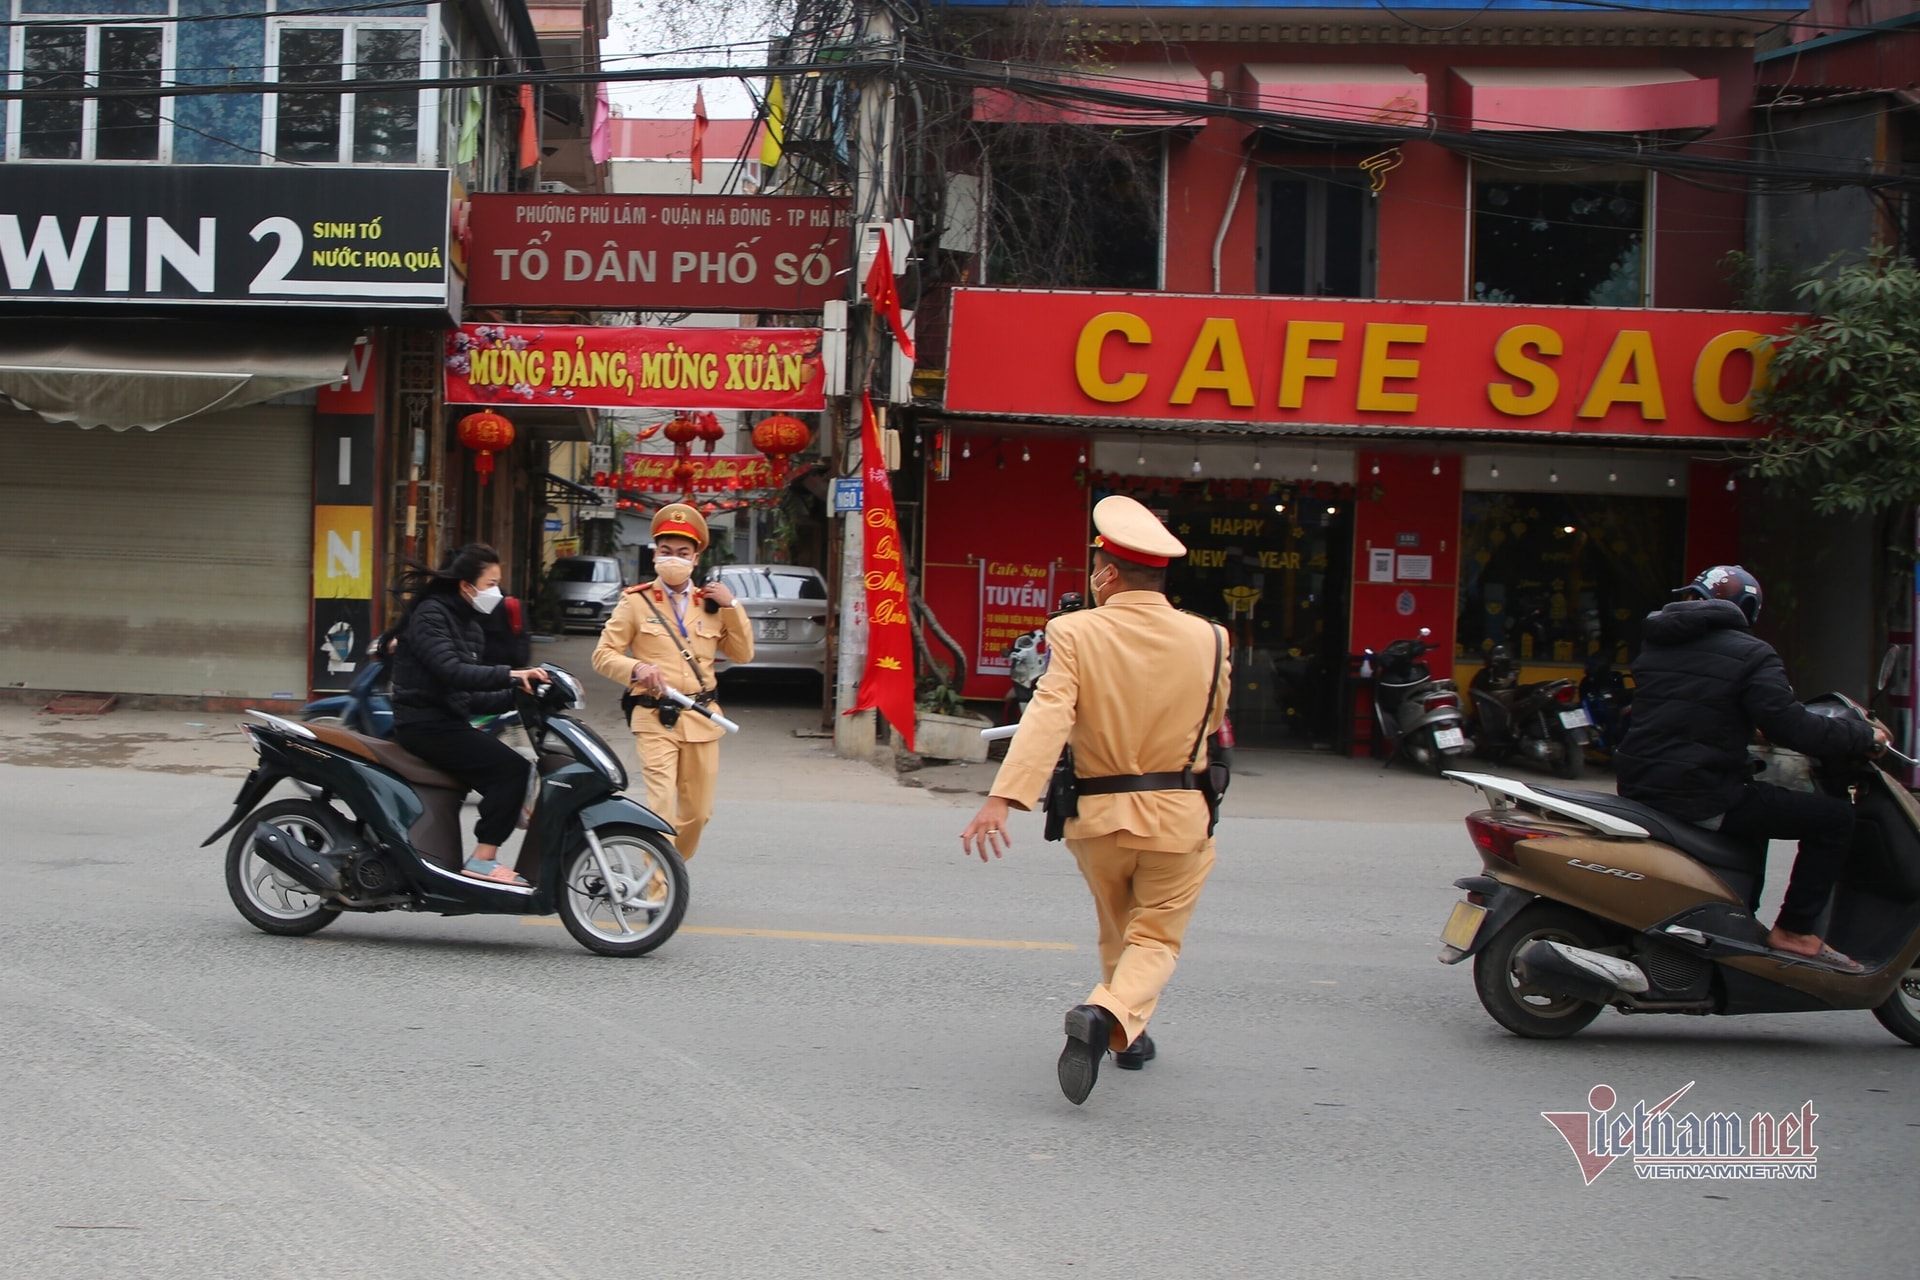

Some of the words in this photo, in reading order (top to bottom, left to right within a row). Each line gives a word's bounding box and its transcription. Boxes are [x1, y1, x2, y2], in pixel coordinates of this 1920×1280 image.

[312, 222, 356, 239] SINH
[360, 217, 382, 240] TỐ
[661, 202, 702, 229] QUẬN
[729, 203, 771, 227] ĐÔNG
[787, 209, 806, 227] TP
[0, 214, 217, 293] WIN
[248, 216, 304, 294] 2
[312, 247, 362, 268] NƯỚC
[365, 251, 401, 269] HOA
[404, 245, 442, 273] QUẢ
[494, 230, 551, 281] TỔ
[563, 240, 657, 283] DÂN
[671, 235, 760, 285] PHỐ
[773, 238, 840, 286] SỐ
[468, 339, 546, 387] MỪNG
[551, 335, 635, 397] ĐẢNG,
[640, 342, 718, 391] MỪNG
[724, 343, 803, 392] XUÂN
[1074, 311, 1429, 412] CAFE
[1487, 324, 1777, 422] SAO
[1210, 518, 1265, 536] HAPPY
[1021, 564, 1047, 578] Sao
[1188, 549, 1229, 567] NEW
[1257, 551, 1301, 569] YEAR
[985, 580, 1047, 608] TUYỂN
[1566, 858, 1646, 880] LEAD
